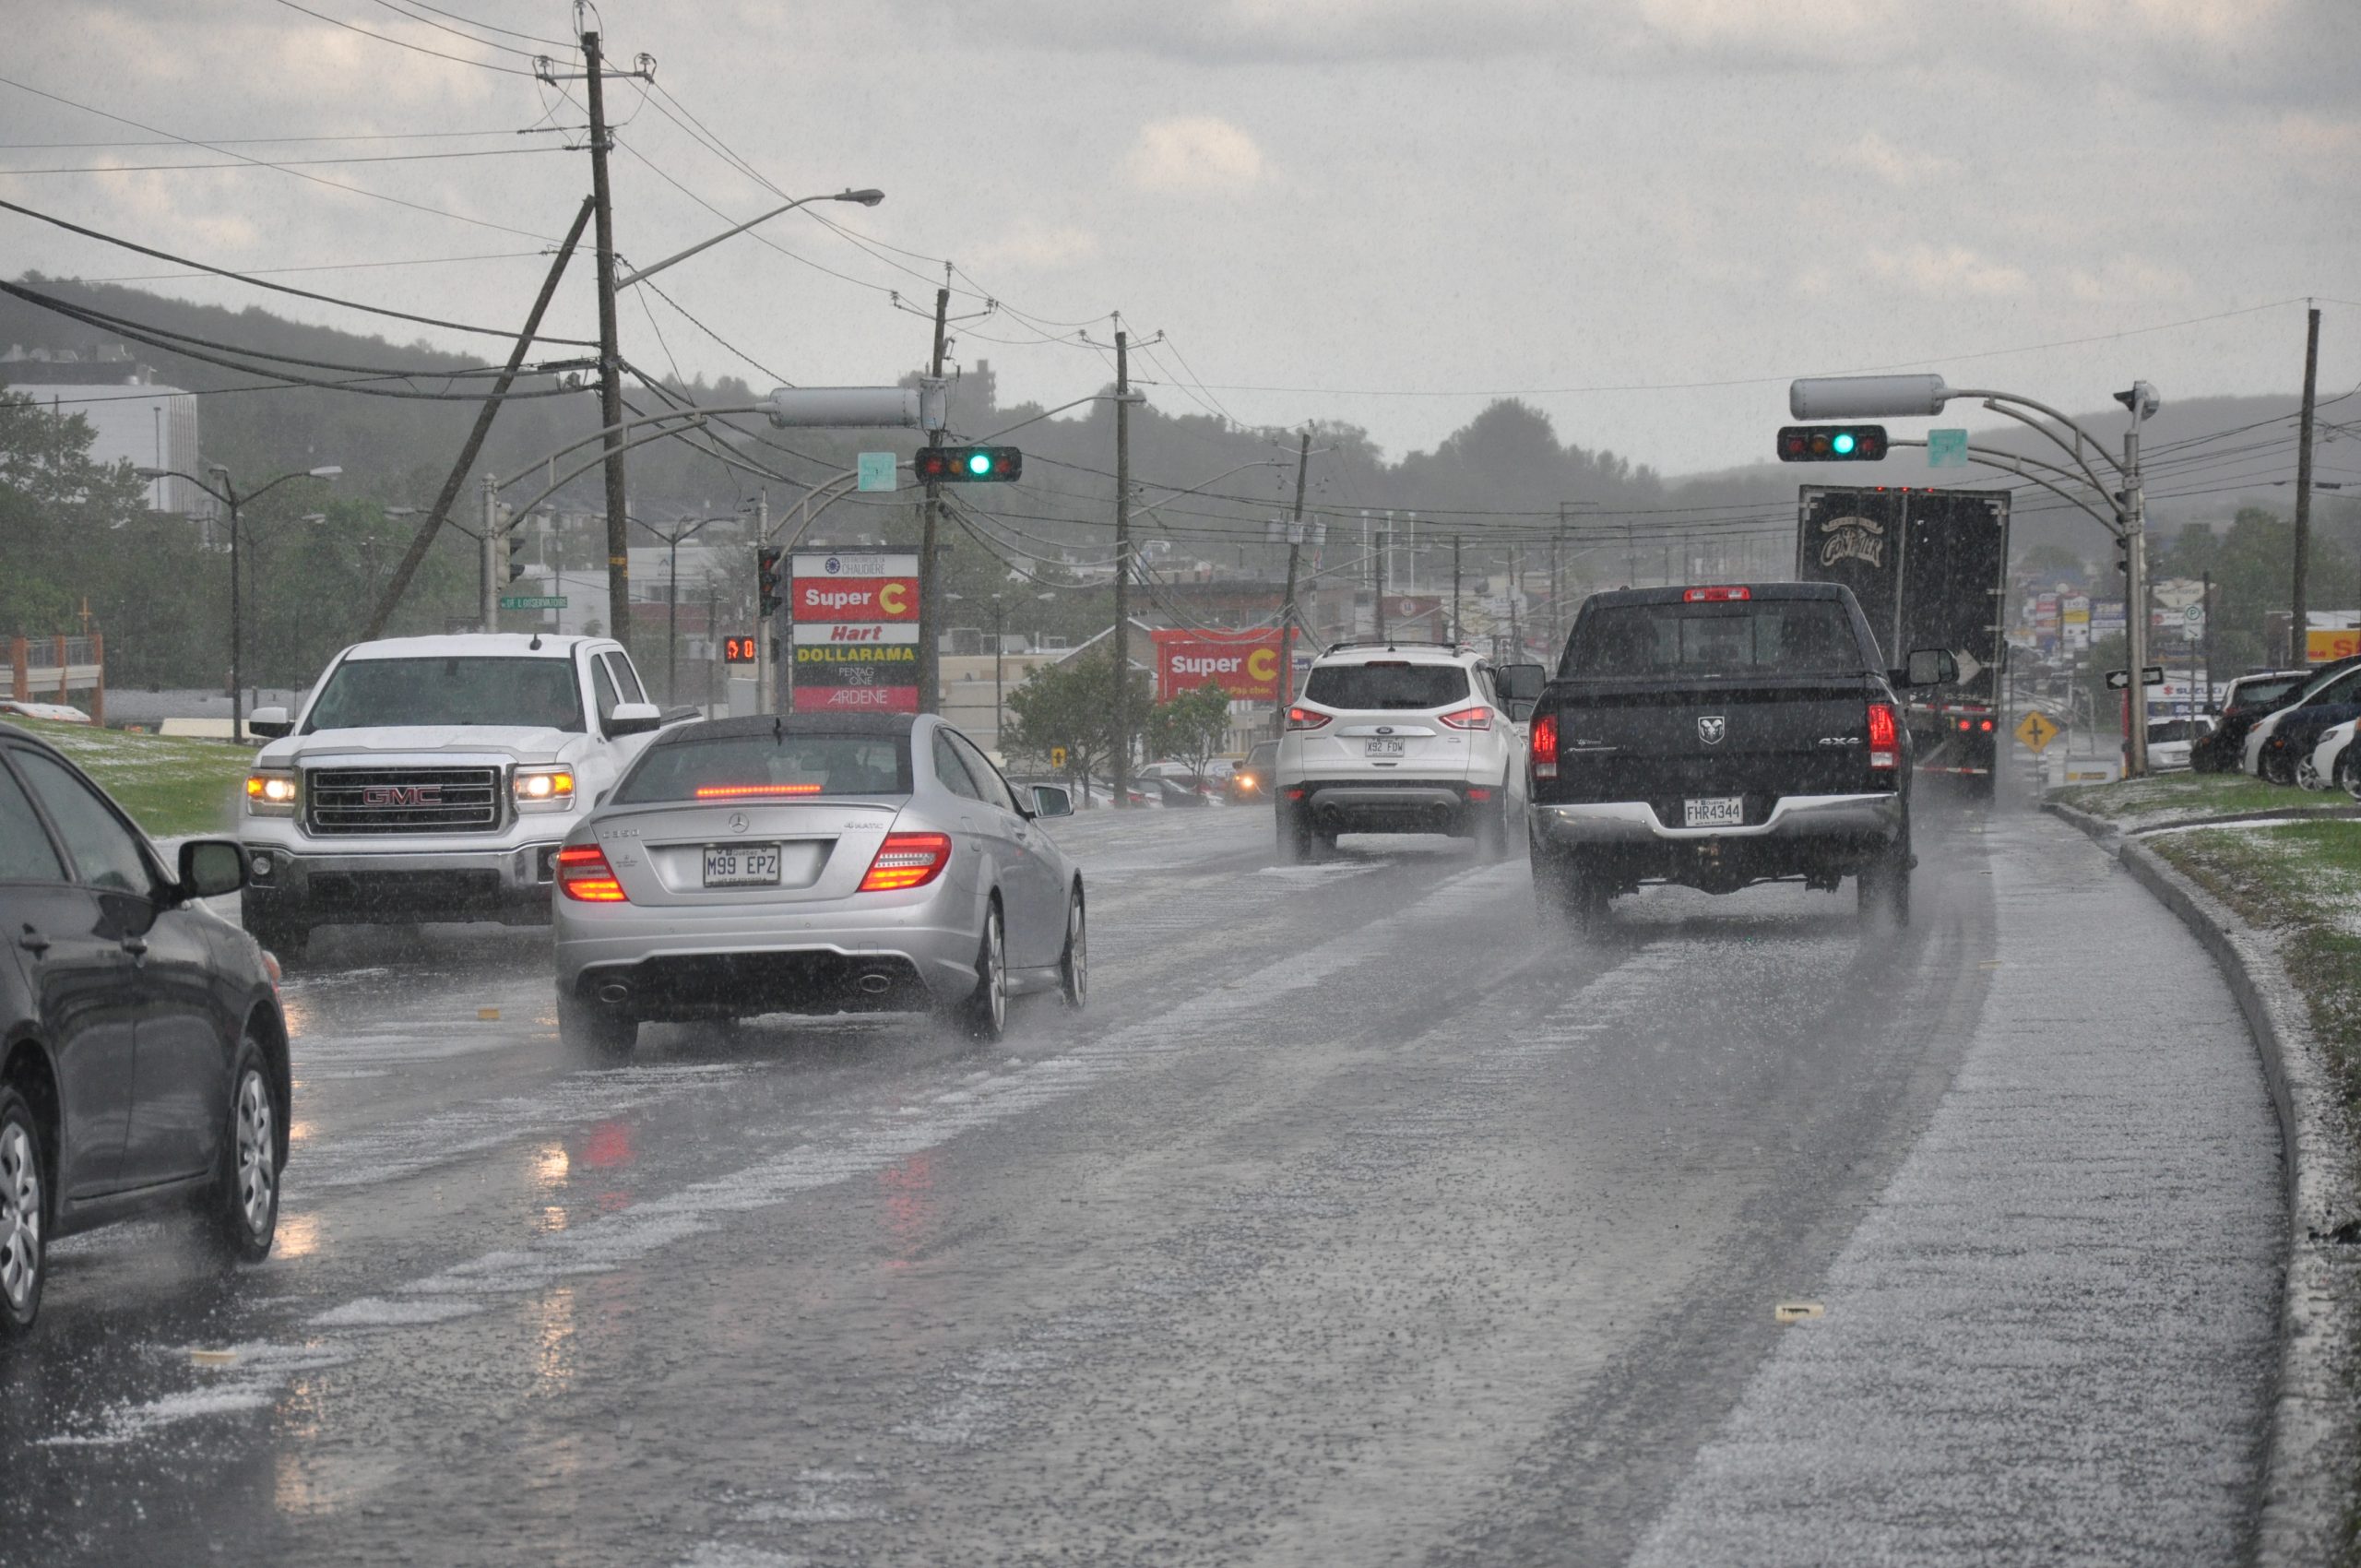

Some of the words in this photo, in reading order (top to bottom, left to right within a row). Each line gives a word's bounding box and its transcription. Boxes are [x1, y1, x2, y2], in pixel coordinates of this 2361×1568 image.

[805, 588, 872, 610] Super
[879, 583, 908, 614] C
[830, 625, 883, 641] Hart
[797, 647, 915, 662] DOLLARAMA
[838, 667, 875, 677] PENTAG
[1171, 655, 1242, 677] Super
[1248, 648, 1277, 682] C
[848, 676, 873, 685] ONE
[827, 689, 888, 705] ARDENE
[1367, 742, 1382, 753] X92
[1387, 742, 1403, 753] FDW
[362, 787, 443, 805] GMC
[1687, 803, 1740, 820] FHR4344
[706, 856, 736, 875] M99
[747, 855, 777, 874] EPZ
